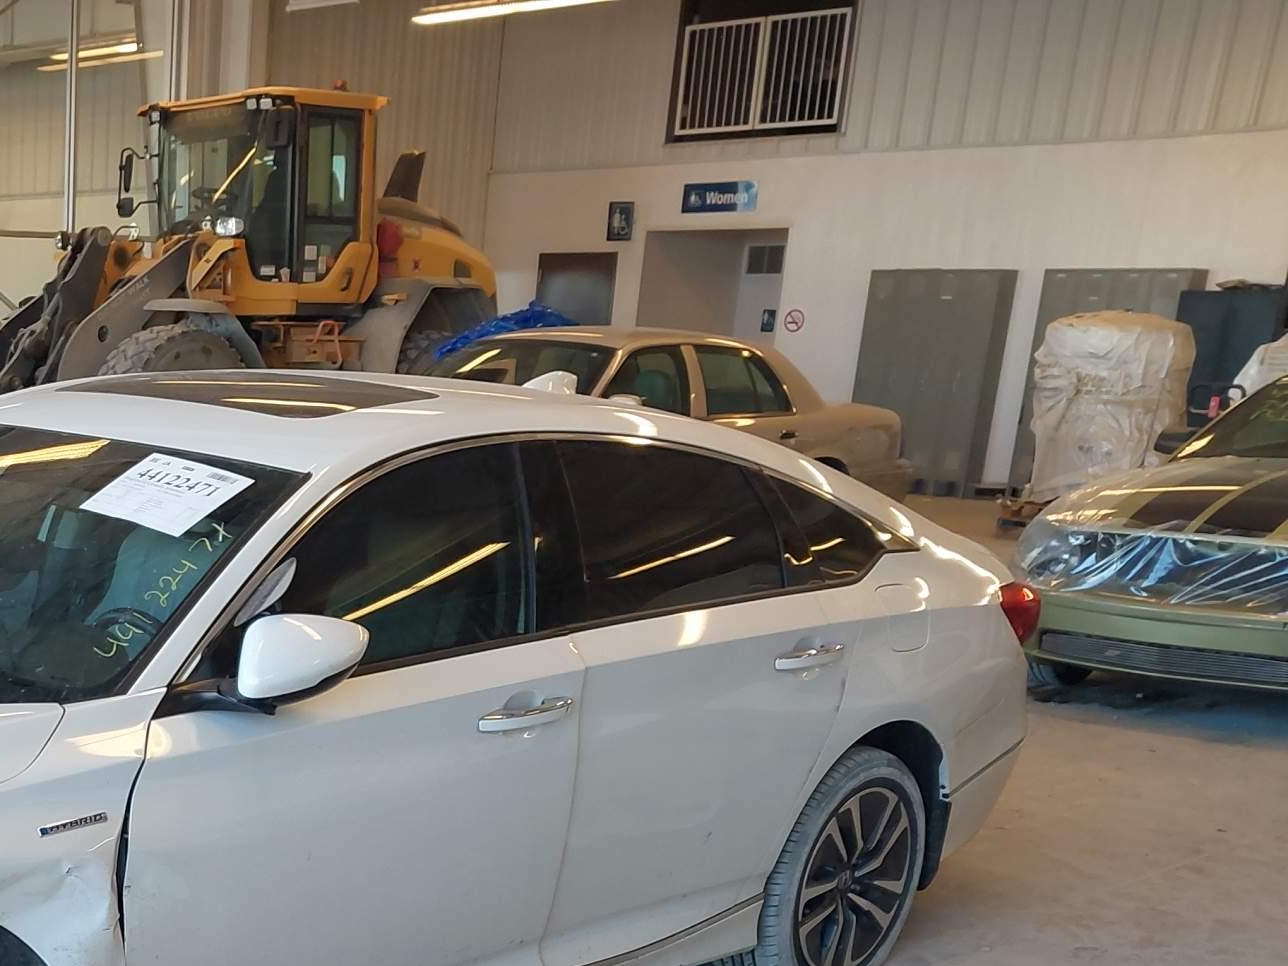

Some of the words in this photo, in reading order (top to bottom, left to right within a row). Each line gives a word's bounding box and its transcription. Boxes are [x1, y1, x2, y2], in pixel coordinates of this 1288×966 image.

[705, 190, 749, 205] Women
[137, 468, 221, 497] 44122471
[47, 811, 107, 834] HYBRID
